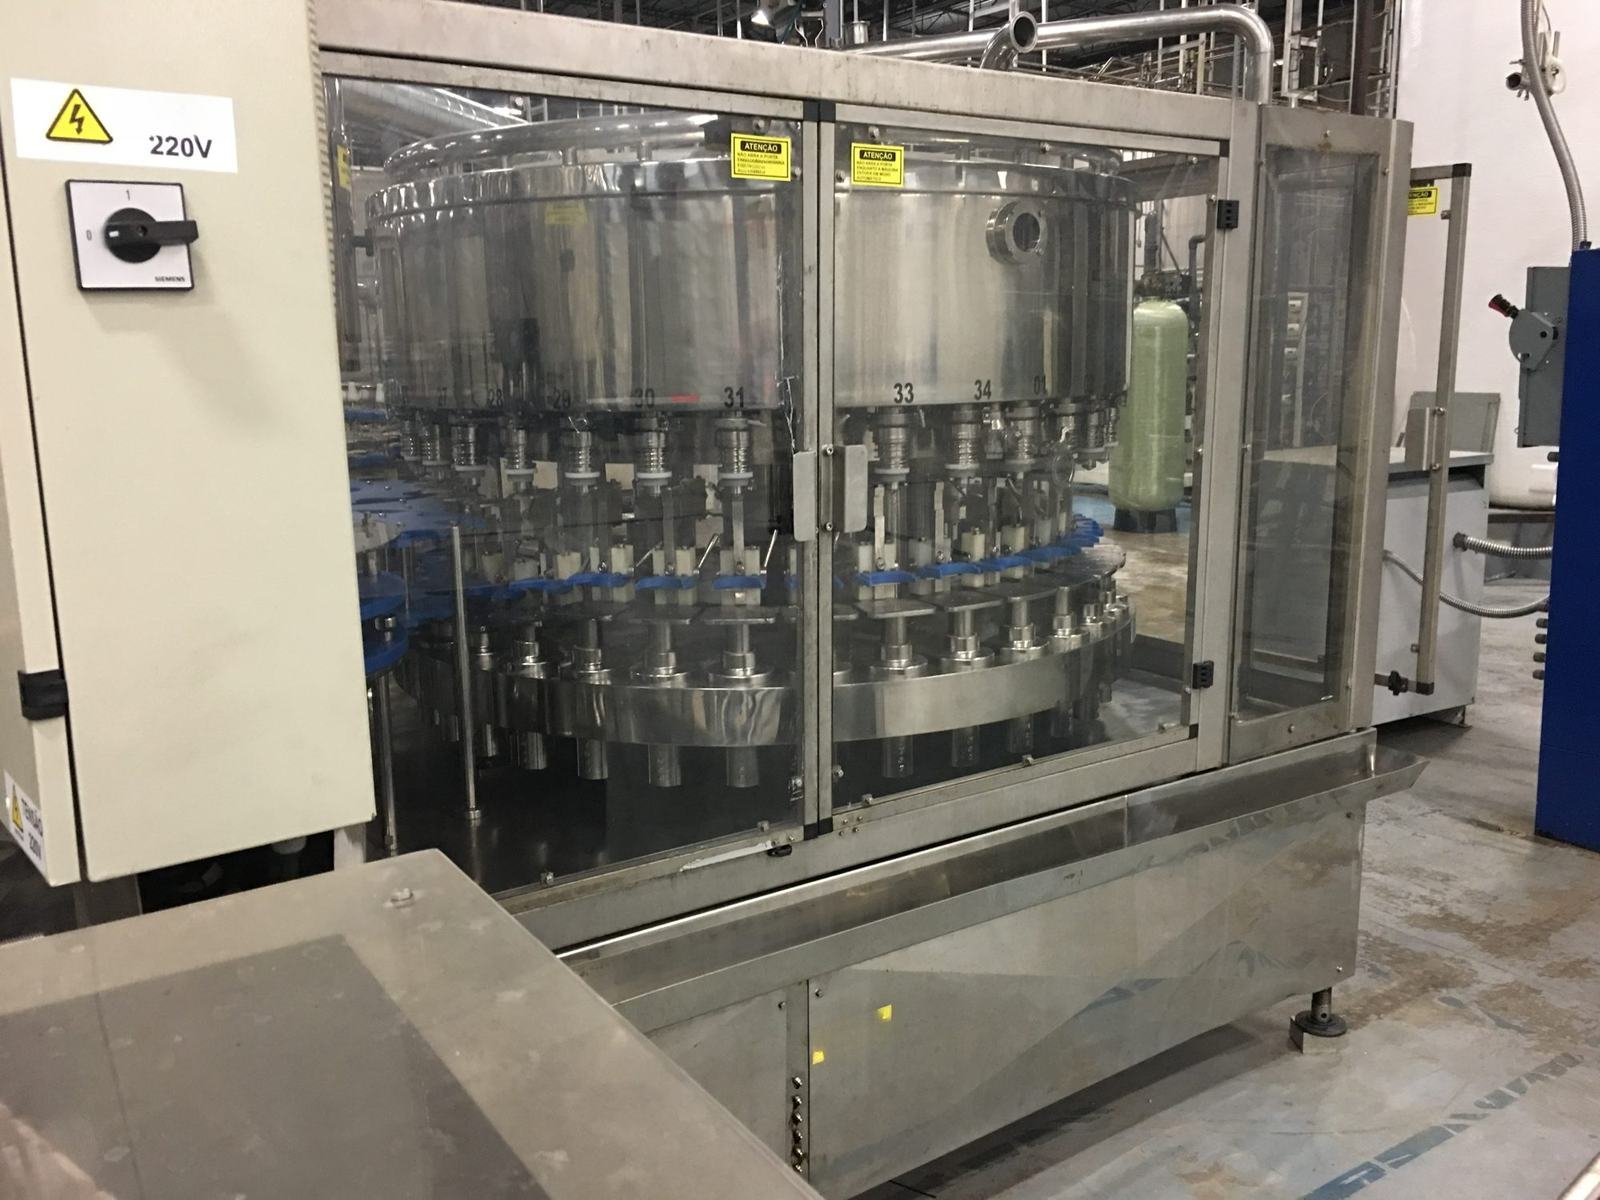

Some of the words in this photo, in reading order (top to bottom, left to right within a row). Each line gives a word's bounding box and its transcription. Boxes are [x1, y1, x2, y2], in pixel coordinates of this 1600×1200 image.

[149, 134, 212, 158] 220V
[744, 142, 778, 152] ATENÇÃO
[863, 151, 893, 160] ATENÇÃO
[86, 229, 93, 241] 0
[633, 387, 655, 409] 30
[724, 386, 745, 408] 31
[893, 382, 914, 404] 33
[974, 379, 992, 400] 34
